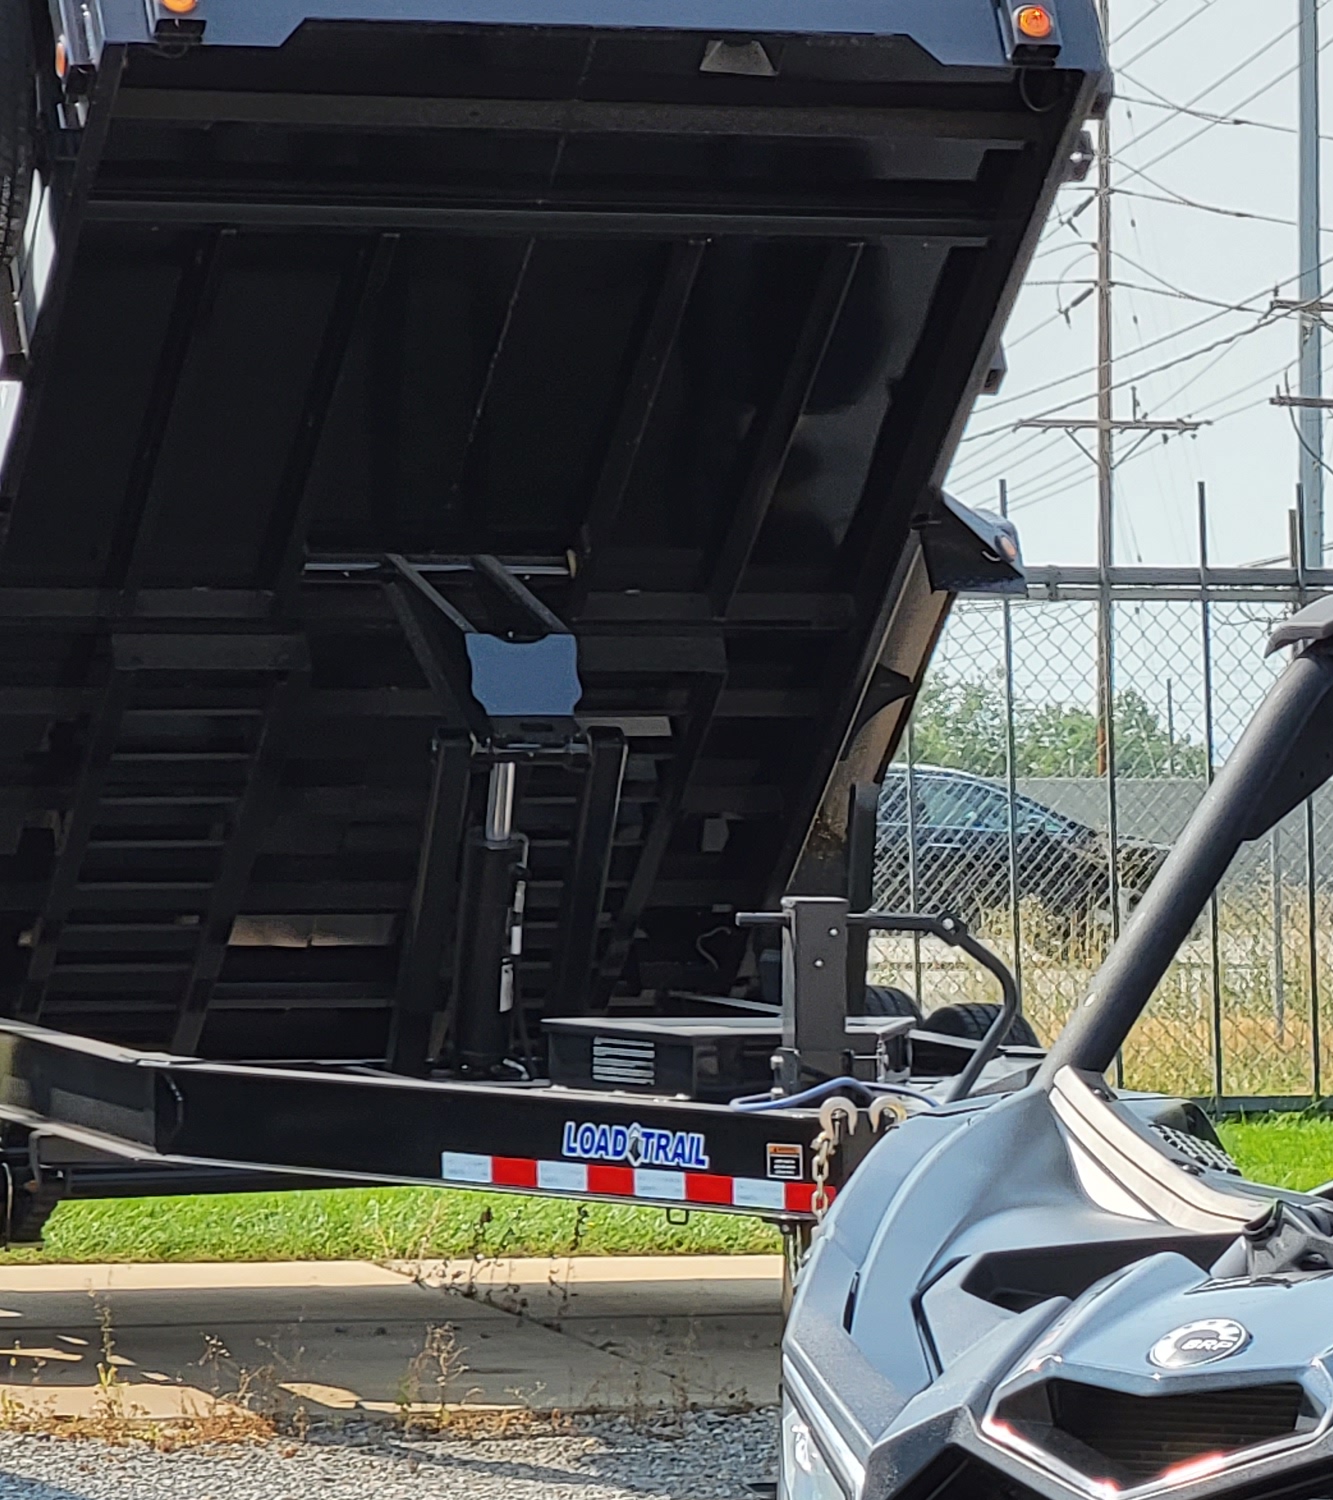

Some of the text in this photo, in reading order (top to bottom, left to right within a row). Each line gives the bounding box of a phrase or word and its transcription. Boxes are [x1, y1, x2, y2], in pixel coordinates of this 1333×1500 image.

[563, 1121, 709, 1169] LOAD TRAIL
[1180, 1338, 1234, 1352] BRP
